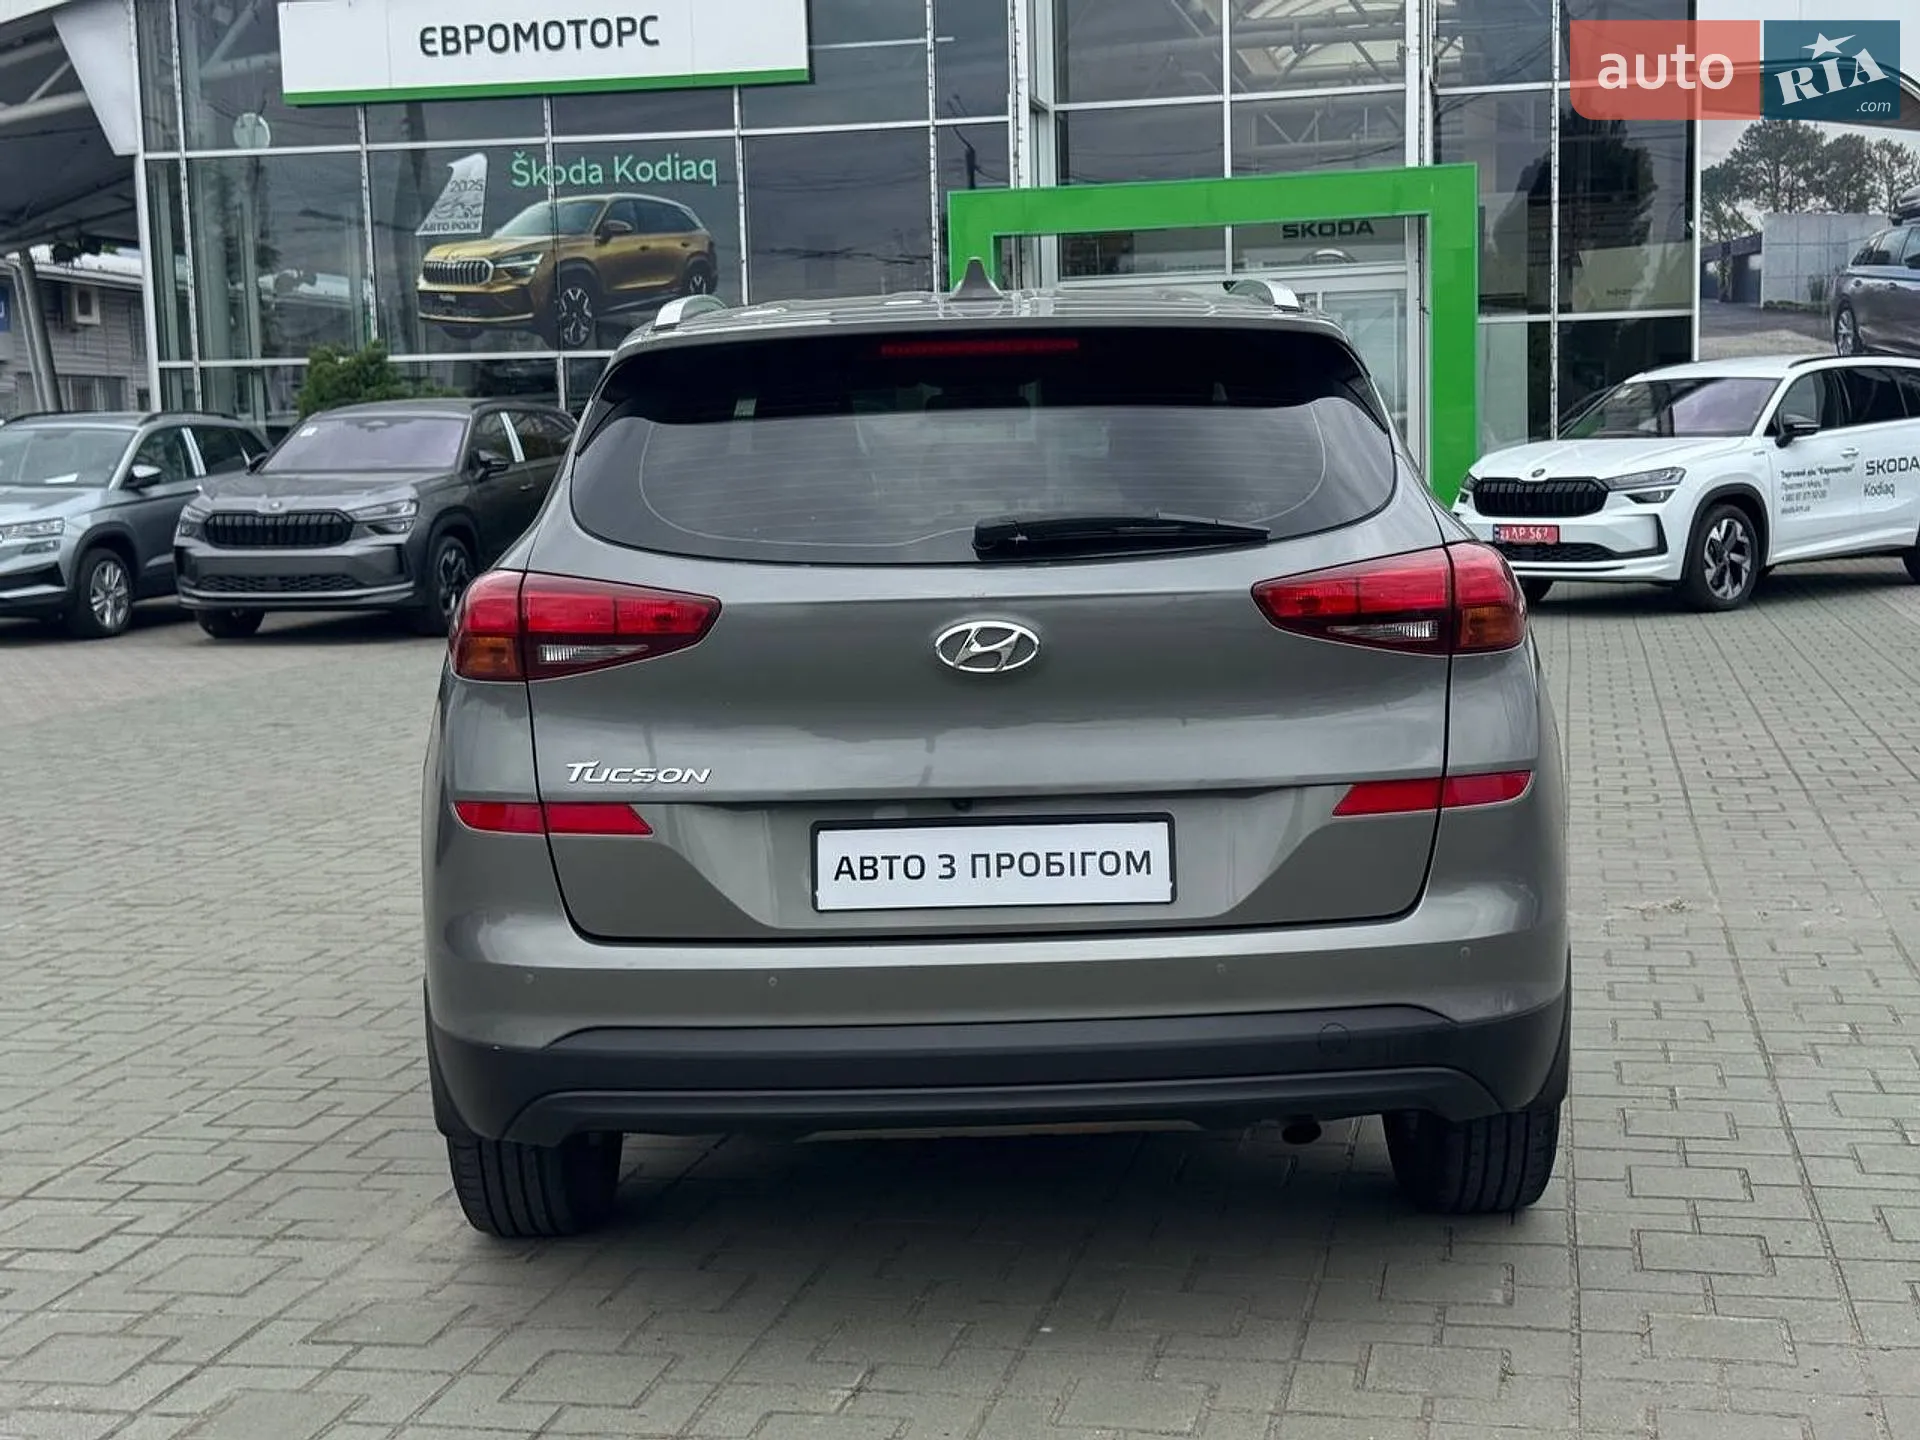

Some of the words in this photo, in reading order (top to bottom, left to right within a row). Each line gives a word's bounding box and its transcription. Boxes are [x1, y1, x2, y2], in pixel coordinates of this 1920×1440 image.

[420, 15, 660, 57] ЄВРОМОТОРС
[511, 151, 603, 187] Škoda
[613, 153, 718, 187] Kodiaq
[1282, 219, 1375, 239] SKODA
[1866, 456, 1920, 476] SKODA
[1864, 482, 1895, 498] Kodiaq
[566, 760, 713, 784] TUCSON
[833, 854, 926, 882] АВТО
[937, 853, 957, 880] З
[970, 850, 1153, 878] ПРОБІГОМ
